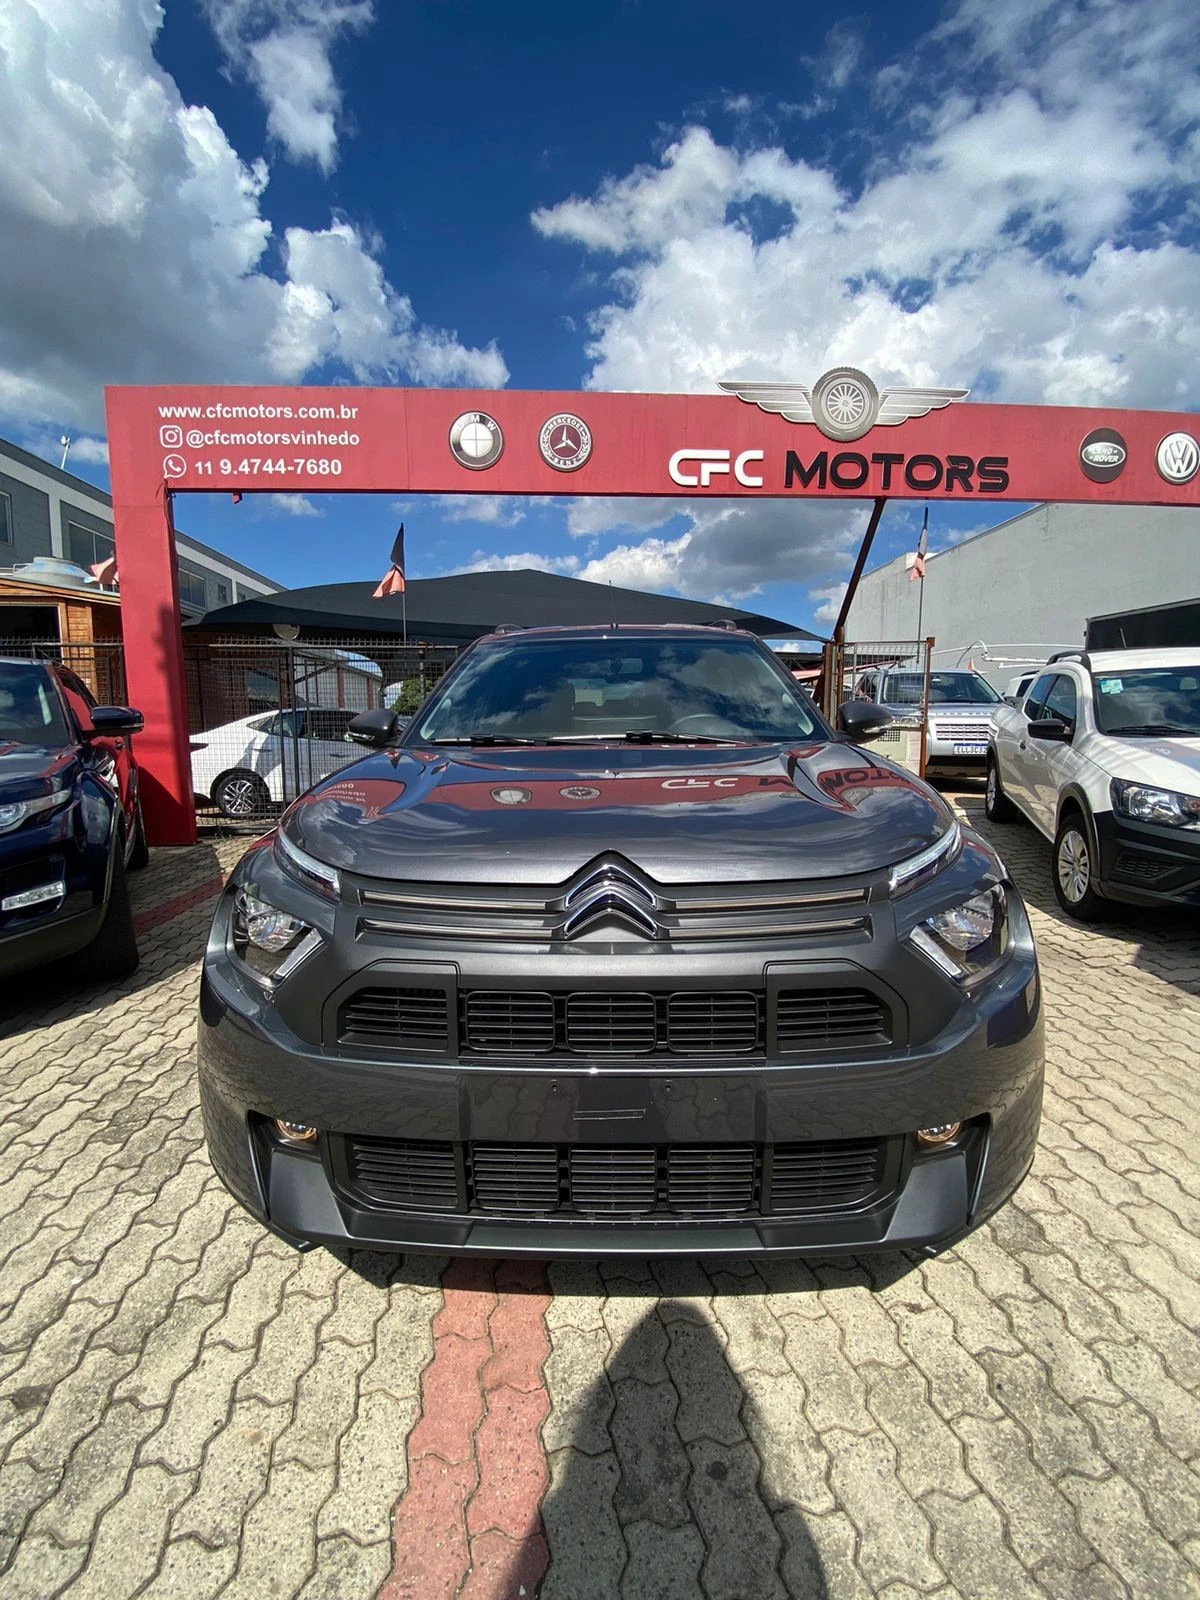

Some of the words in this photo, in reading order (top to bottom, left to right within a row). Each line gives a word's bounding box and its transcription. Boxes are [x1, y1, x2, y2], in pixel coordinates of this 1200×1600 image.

[158, 403, 359, 419] www.cfcmotors.com.br
[547, 416, 585, 433] MERCEDES
[186, 429, 360, 449] @cfcmotorsvinhedo
[195, 460, 212, 475] 11
[220, 458, 342, 475] 9.4744-7680
[668, 448, 764, 487] CFC
[784, 450, 1010, 493] MOTORS
